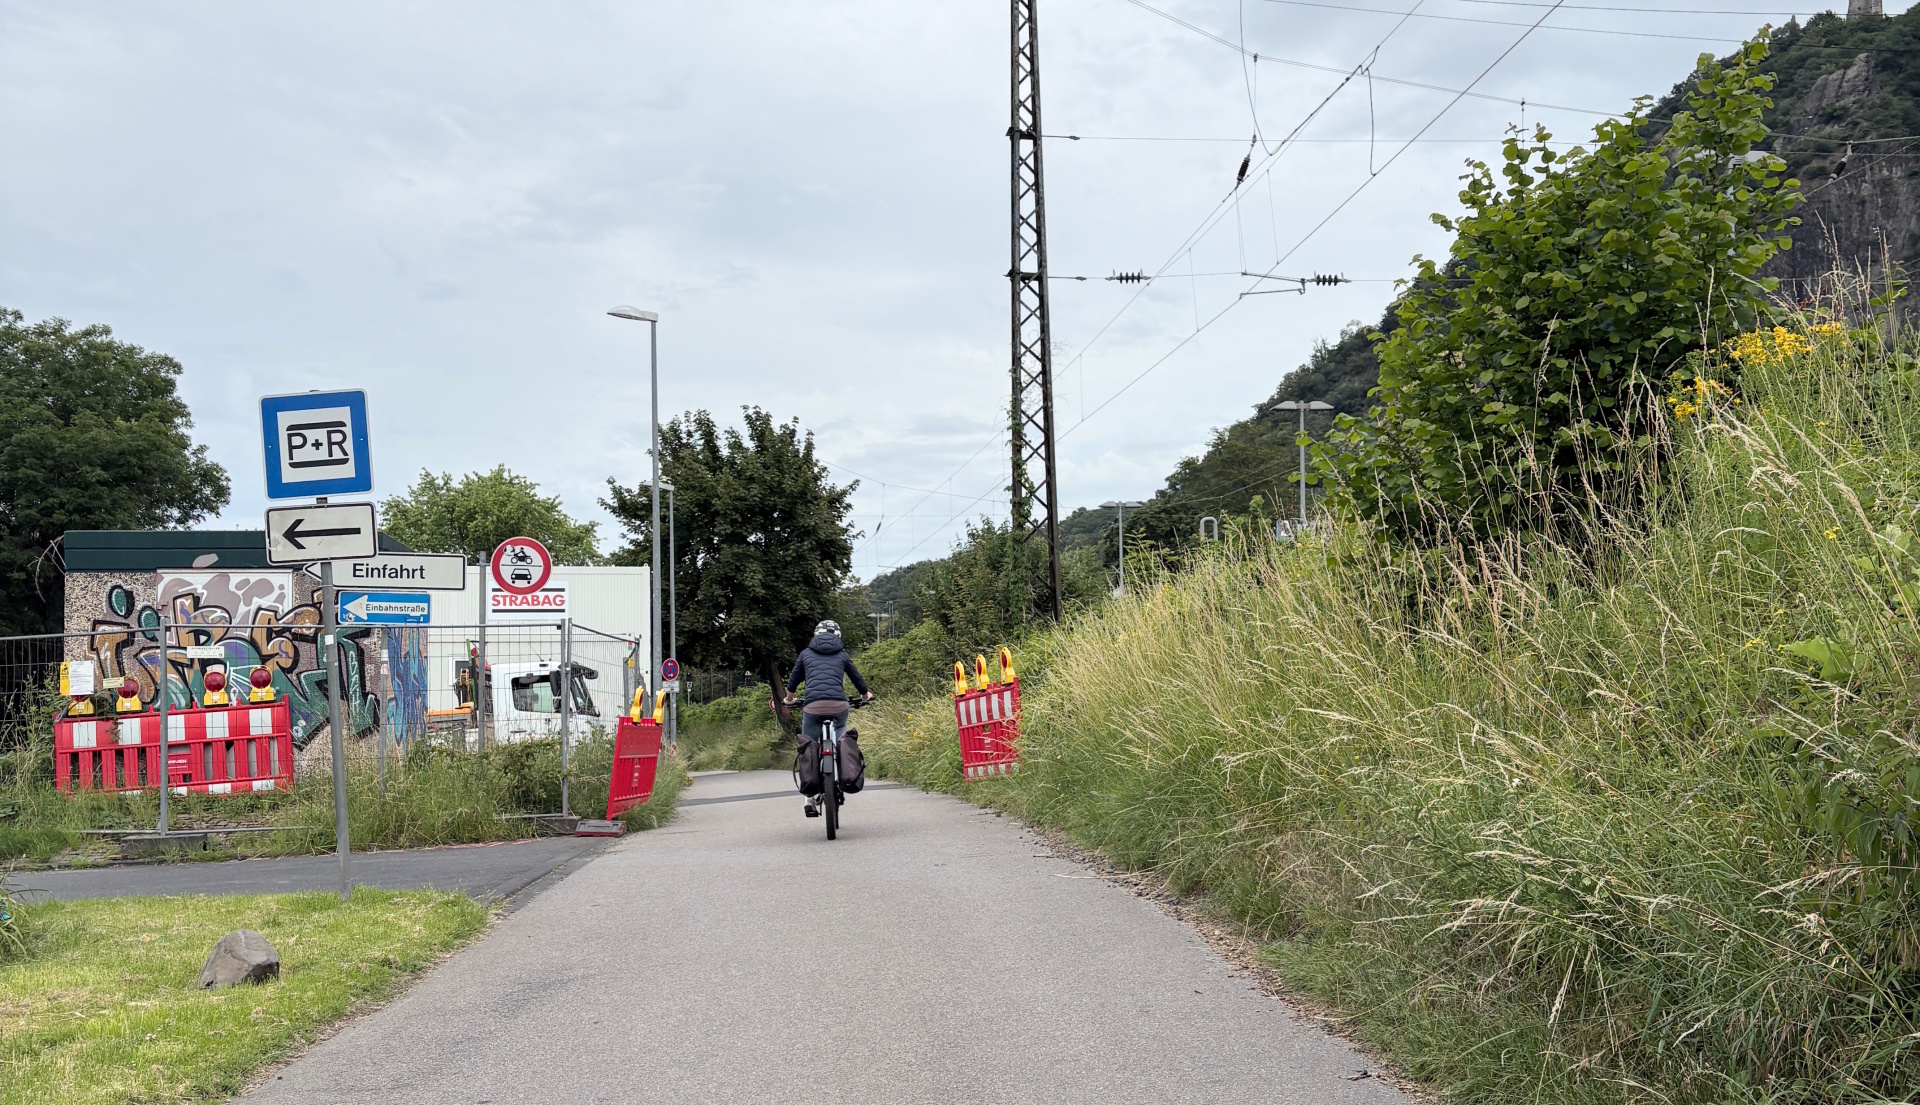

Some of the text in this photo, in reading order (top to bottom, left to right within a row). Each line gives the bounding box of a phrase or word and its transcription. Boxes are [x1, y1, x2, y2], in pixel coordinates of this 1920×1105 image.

[287, 429, 349, 461] P+R
[352, 563, 426, 580] Einfahrt
[365, 603, 426, 613] Einbahnstraße
[491, 594, 566, 607] STRABAG
